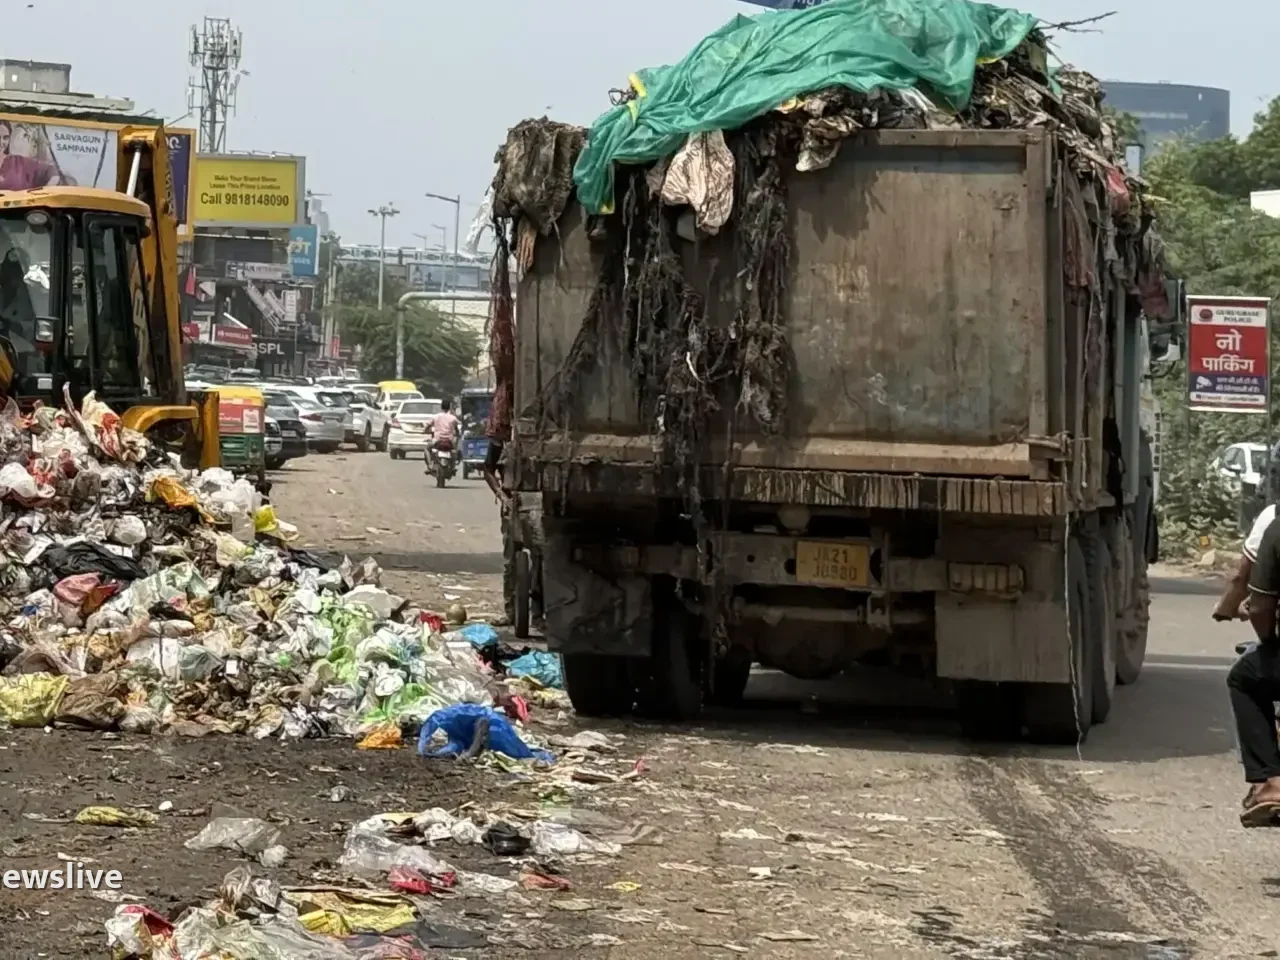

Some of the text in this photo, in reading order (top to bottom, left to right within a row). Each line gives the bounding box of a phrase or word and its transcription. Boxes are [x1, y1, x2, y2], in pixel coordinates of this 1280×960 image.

[54, 132, 101, 144] SARVAGUN
[56, 144, 99, 154] SAMPANN
[200, 192, 222, 204] Call
[1214, 328, 1242, 351] नो
